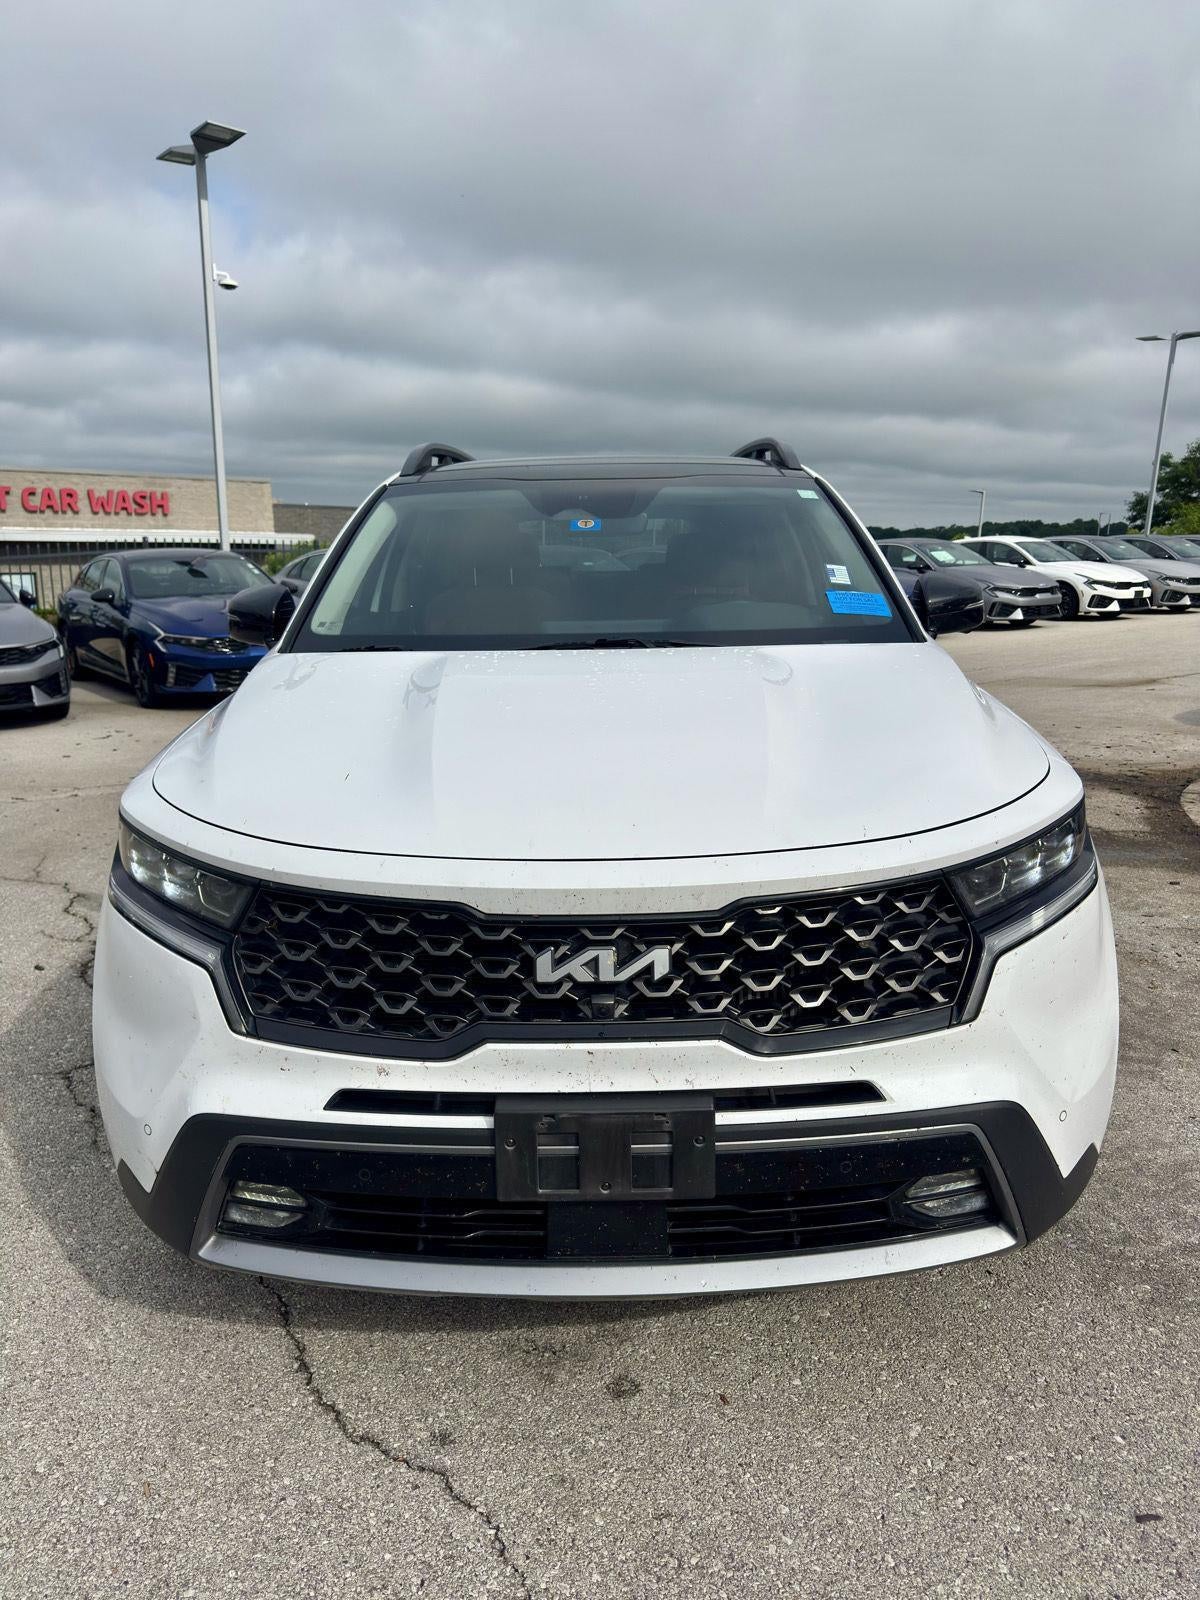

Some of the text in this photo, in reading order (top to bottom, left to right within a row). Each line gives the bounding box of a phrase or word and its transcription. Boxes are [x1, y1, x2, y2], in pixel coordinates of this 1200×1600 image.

[21, 487, 80, 514] CAR
[88, 489, 170, 516] WASH
[536, 946, 671, 982] KIA
